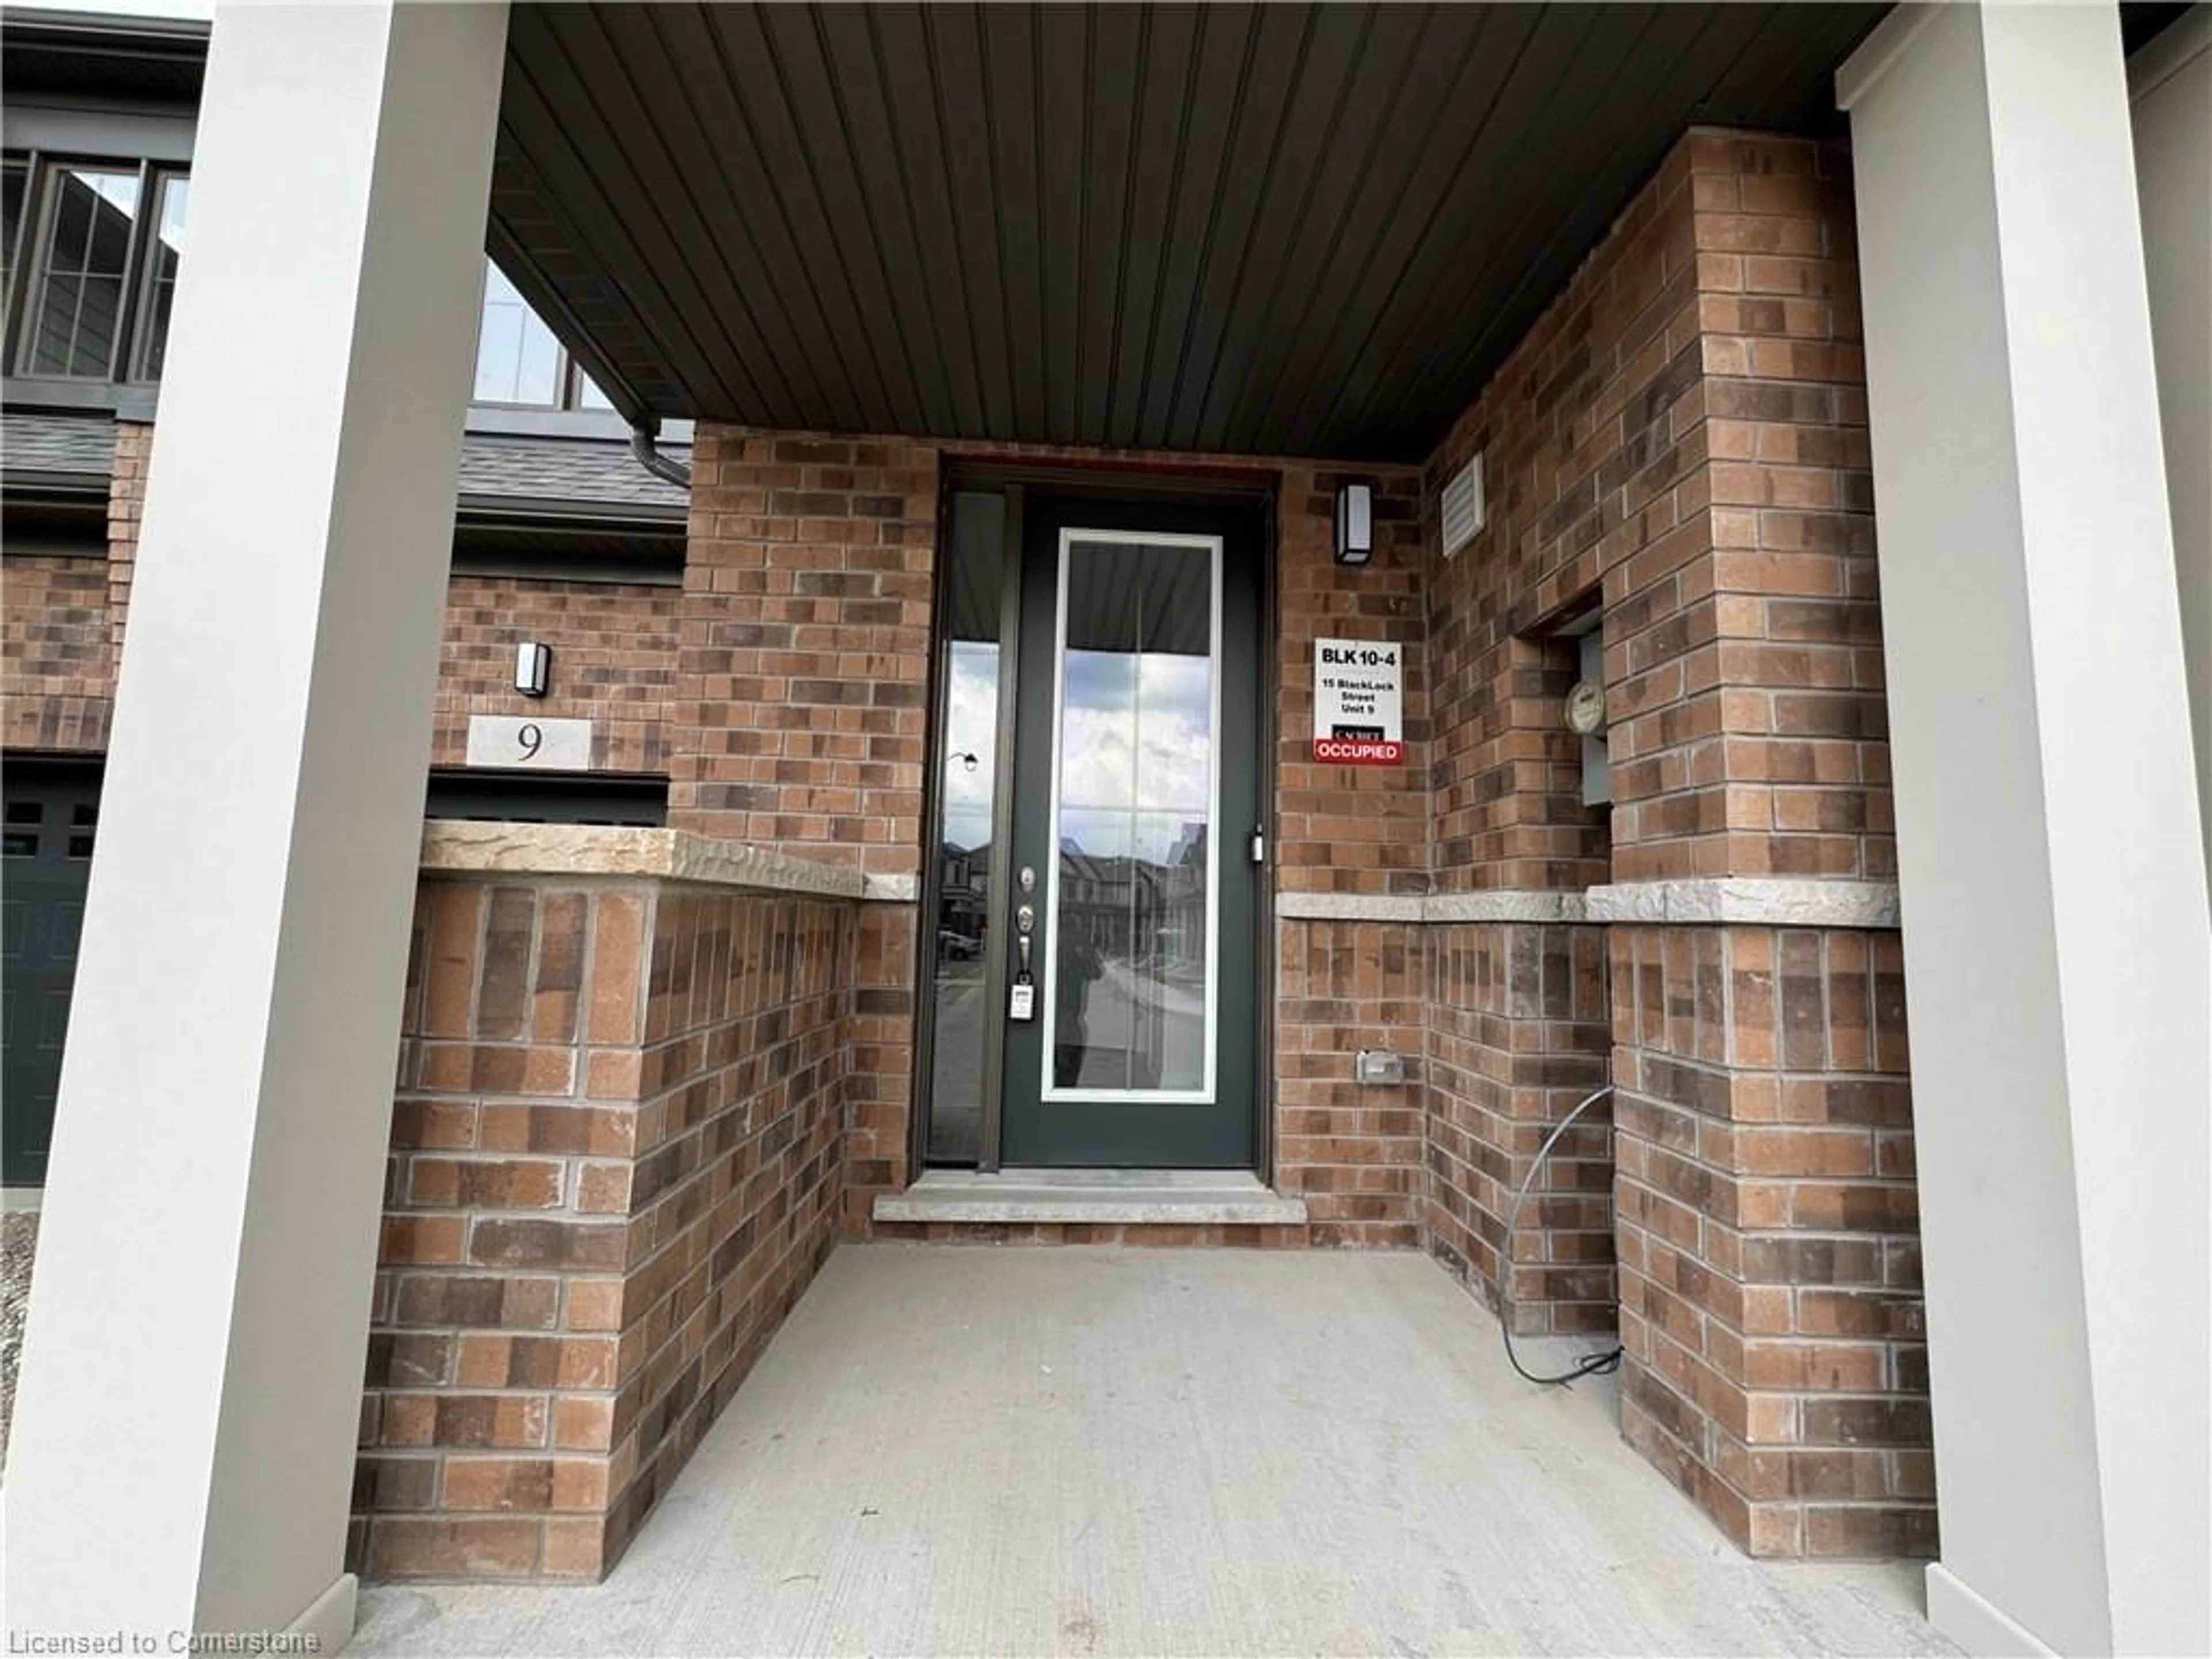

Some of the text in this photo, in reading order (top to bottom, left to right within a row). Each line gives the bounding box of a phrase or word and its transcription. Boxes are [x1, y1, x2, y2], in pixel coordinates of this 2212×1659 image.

[1322, 648, 1396, 666] BLK 10-4
[1323, 678, 1335, 688] 15
[1342, 691, 1375, 702] Street
[1341, 704, 1375, 714] Unit 9
[518, 723, 542, 762] 9
[1317, 743, 1397, 759] OCCUPIED
